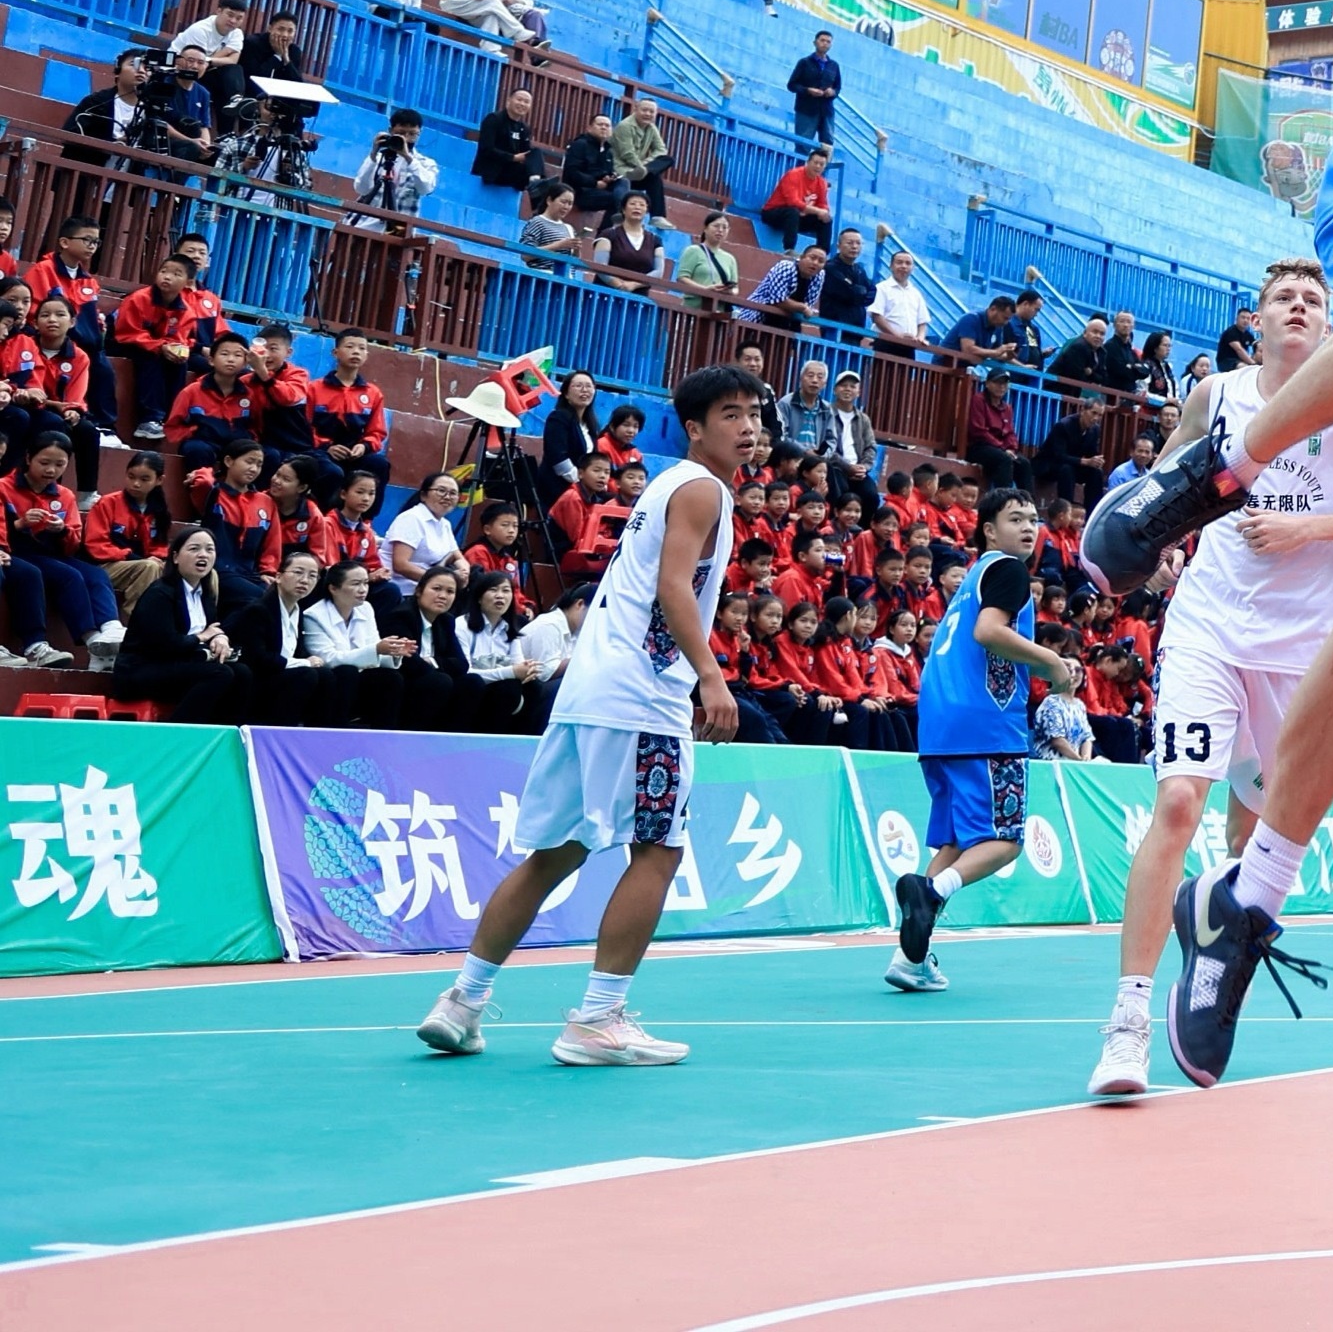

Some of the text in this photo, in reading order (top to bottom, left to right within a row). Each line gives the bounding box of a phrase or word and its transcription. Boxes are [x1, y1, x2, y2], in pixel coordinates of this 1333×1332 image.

[1268, 457, 1324, 503] LESS YOUTH
[1162, 721, 1212, 764] 13
[7, 764, 159, 922] 魂
